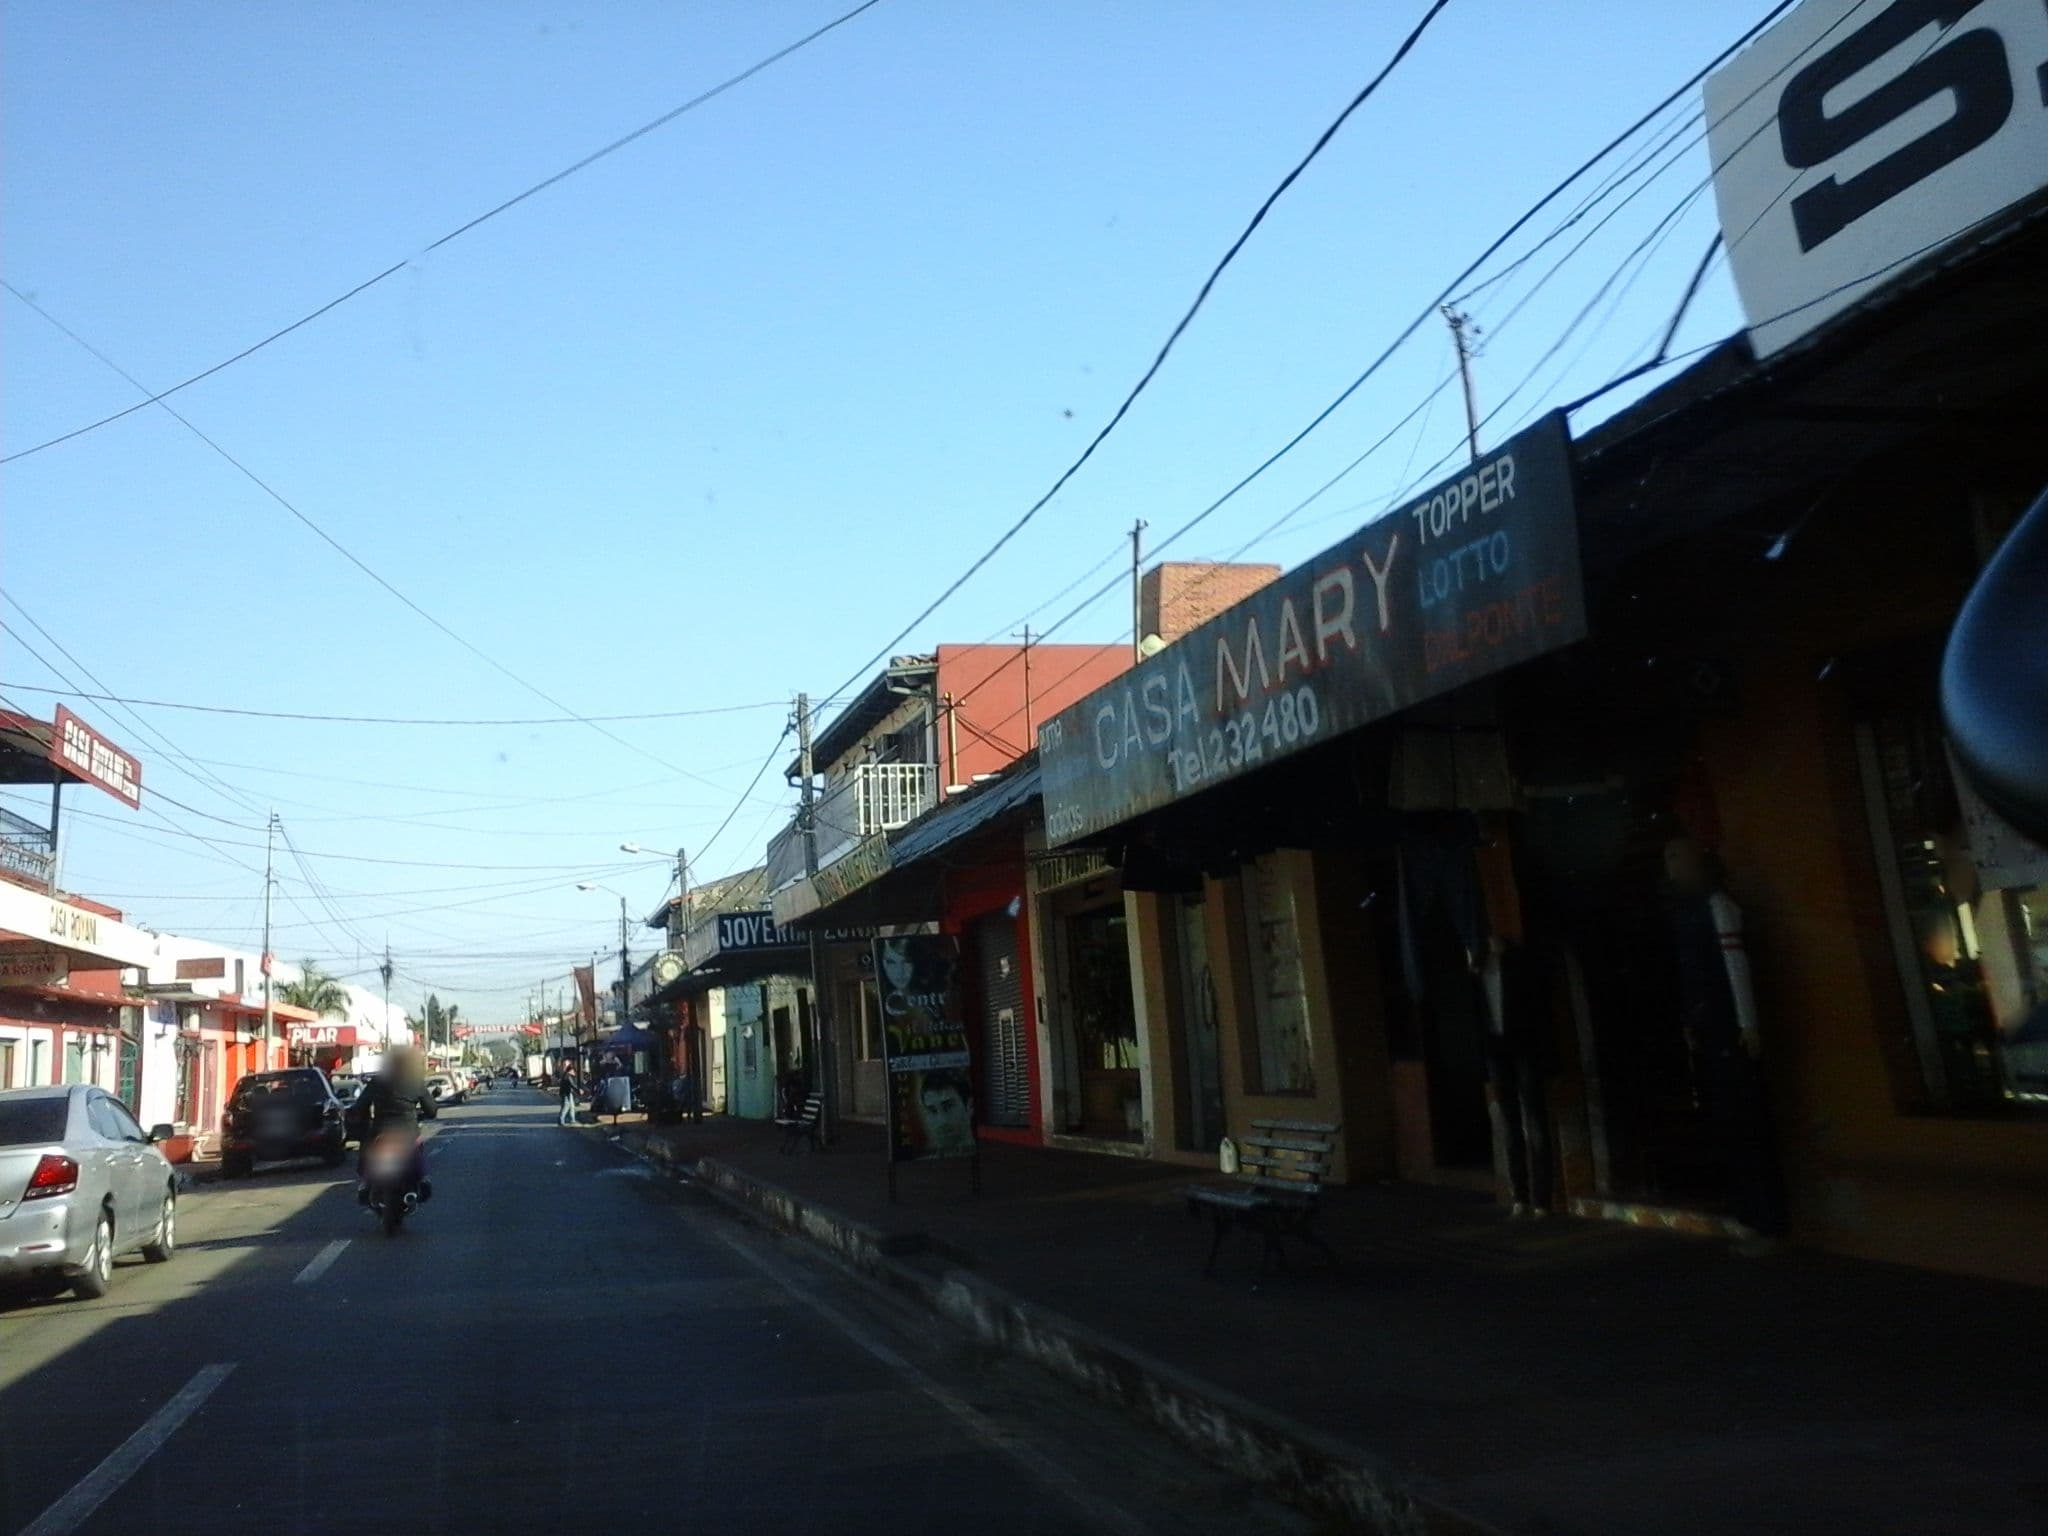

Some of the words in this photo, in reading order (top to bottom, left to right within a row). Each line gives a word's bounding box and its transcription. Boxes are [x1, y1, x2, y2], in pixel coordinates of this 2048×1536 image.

[1778, 0, 2048, 253] S
[1412, 454, 1515, 545] TOPPER
[1419, 531, 1509, 608] LOTTO
[1096, 660, 1199, 769] CASA
[1215, 533, 1398, 715] MARY
[291, 1027, 338, 1048] PILAR
